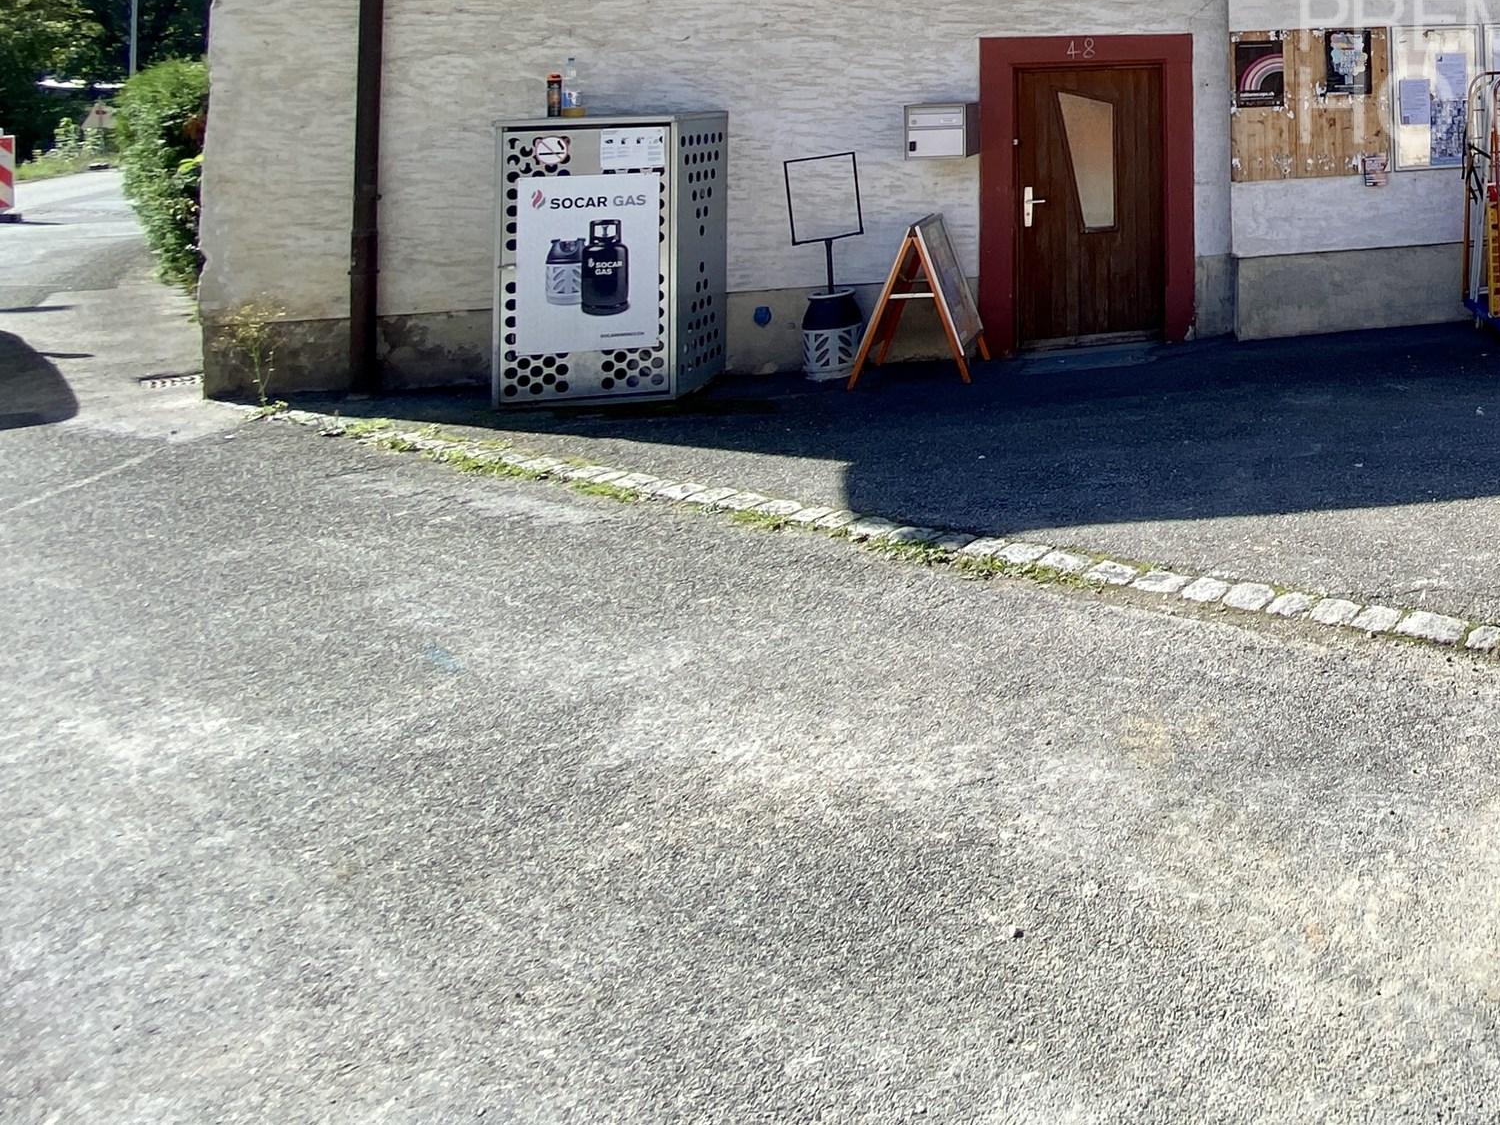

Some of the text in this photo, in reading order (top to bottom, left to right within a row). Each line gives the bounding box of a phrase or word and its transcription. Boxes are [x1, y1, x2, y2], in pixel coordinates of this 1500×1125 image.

[1066, 37, 1096, 60] 48
[550, 194, 647, 210] SOCAR GAS
[595, 260, 623, 268] SOCAR
